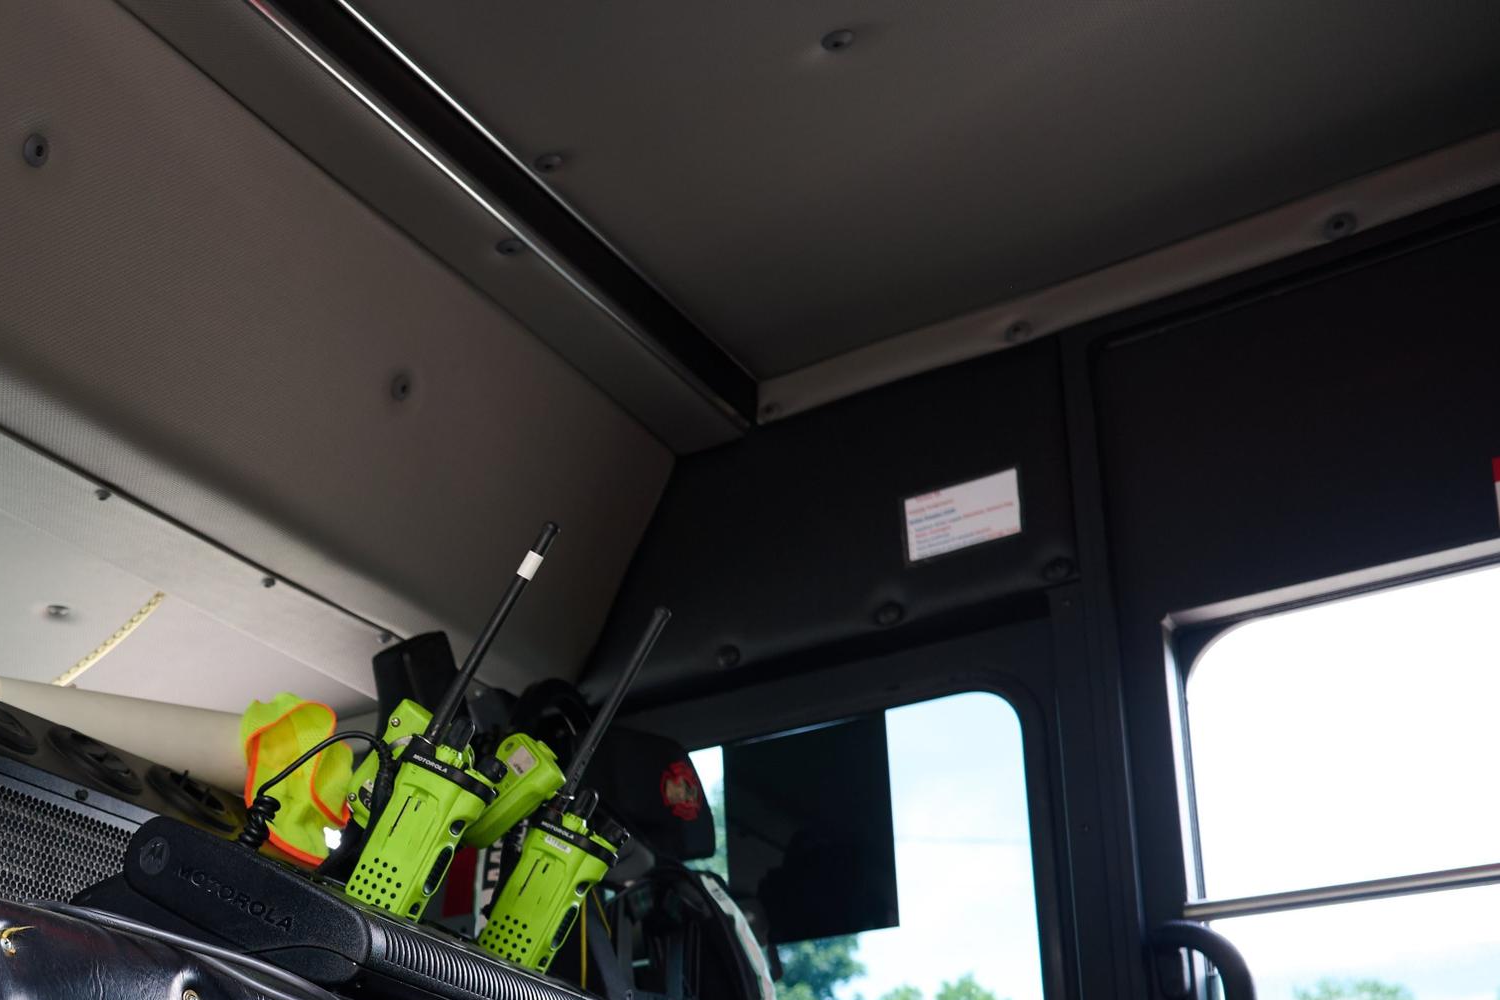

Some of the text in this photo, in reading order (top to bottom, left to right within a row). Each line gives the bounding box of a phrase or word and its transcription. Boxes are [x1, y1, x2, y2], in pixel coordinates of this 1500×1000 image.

[412, 753, 449, 774] MOTOROLA
[541, 820, 575, 840] MOTOROLA
[178, 866, 293, 932] MOTOROLA
